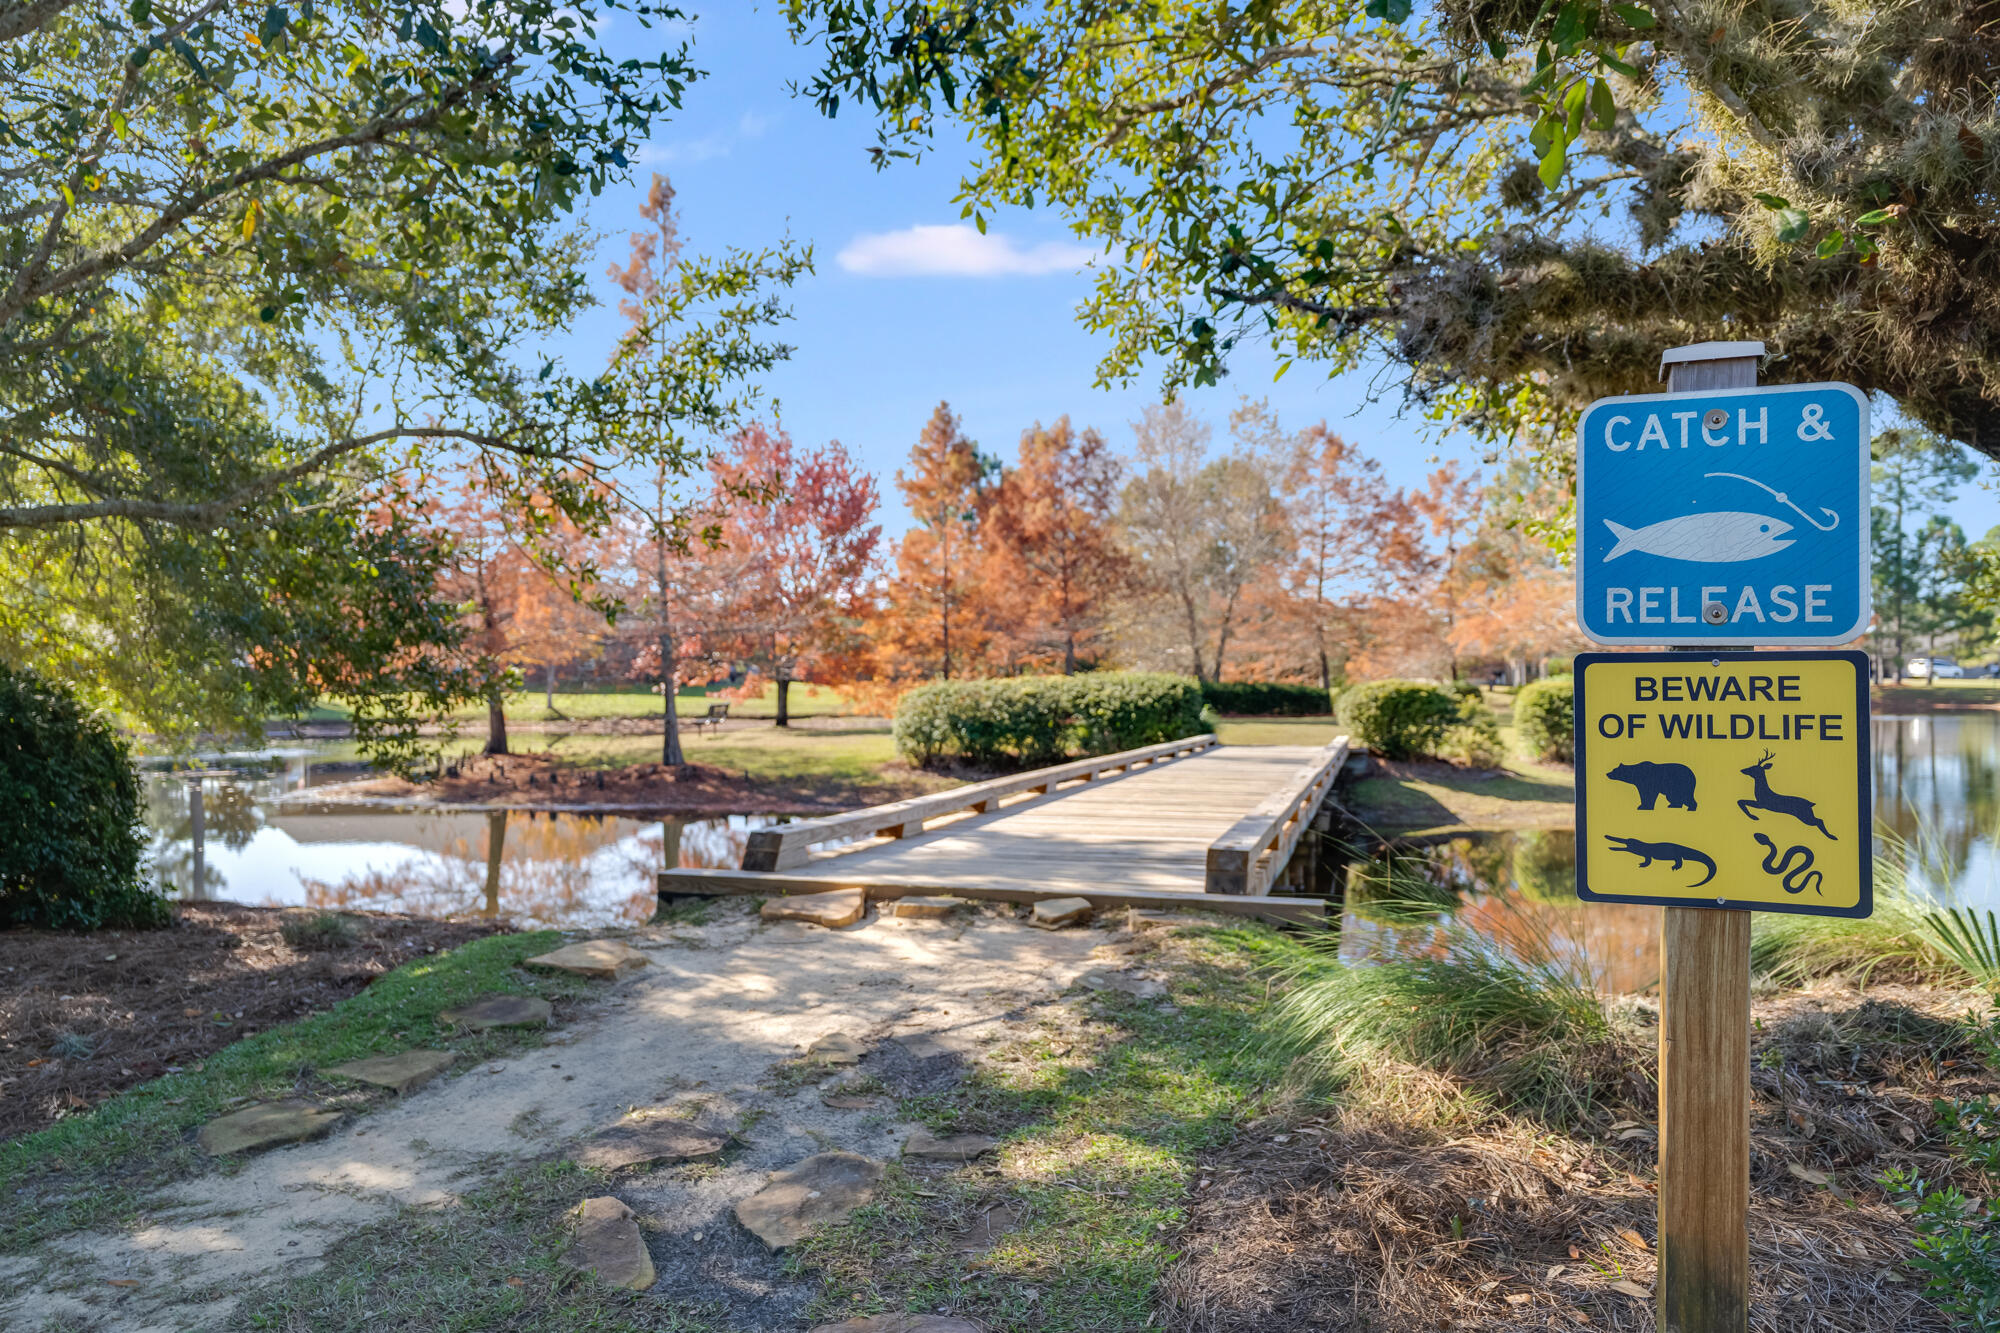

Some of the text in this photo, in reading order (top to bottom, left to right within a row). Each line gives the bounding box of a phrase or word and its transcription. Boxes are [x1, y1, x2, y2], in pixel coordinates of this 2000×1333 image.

[1796, 403, 1836, 442] &
[1635, 675, 1801, 702] BEWARE
[1598, 713, 1844, 741] OF WILDLIFE
